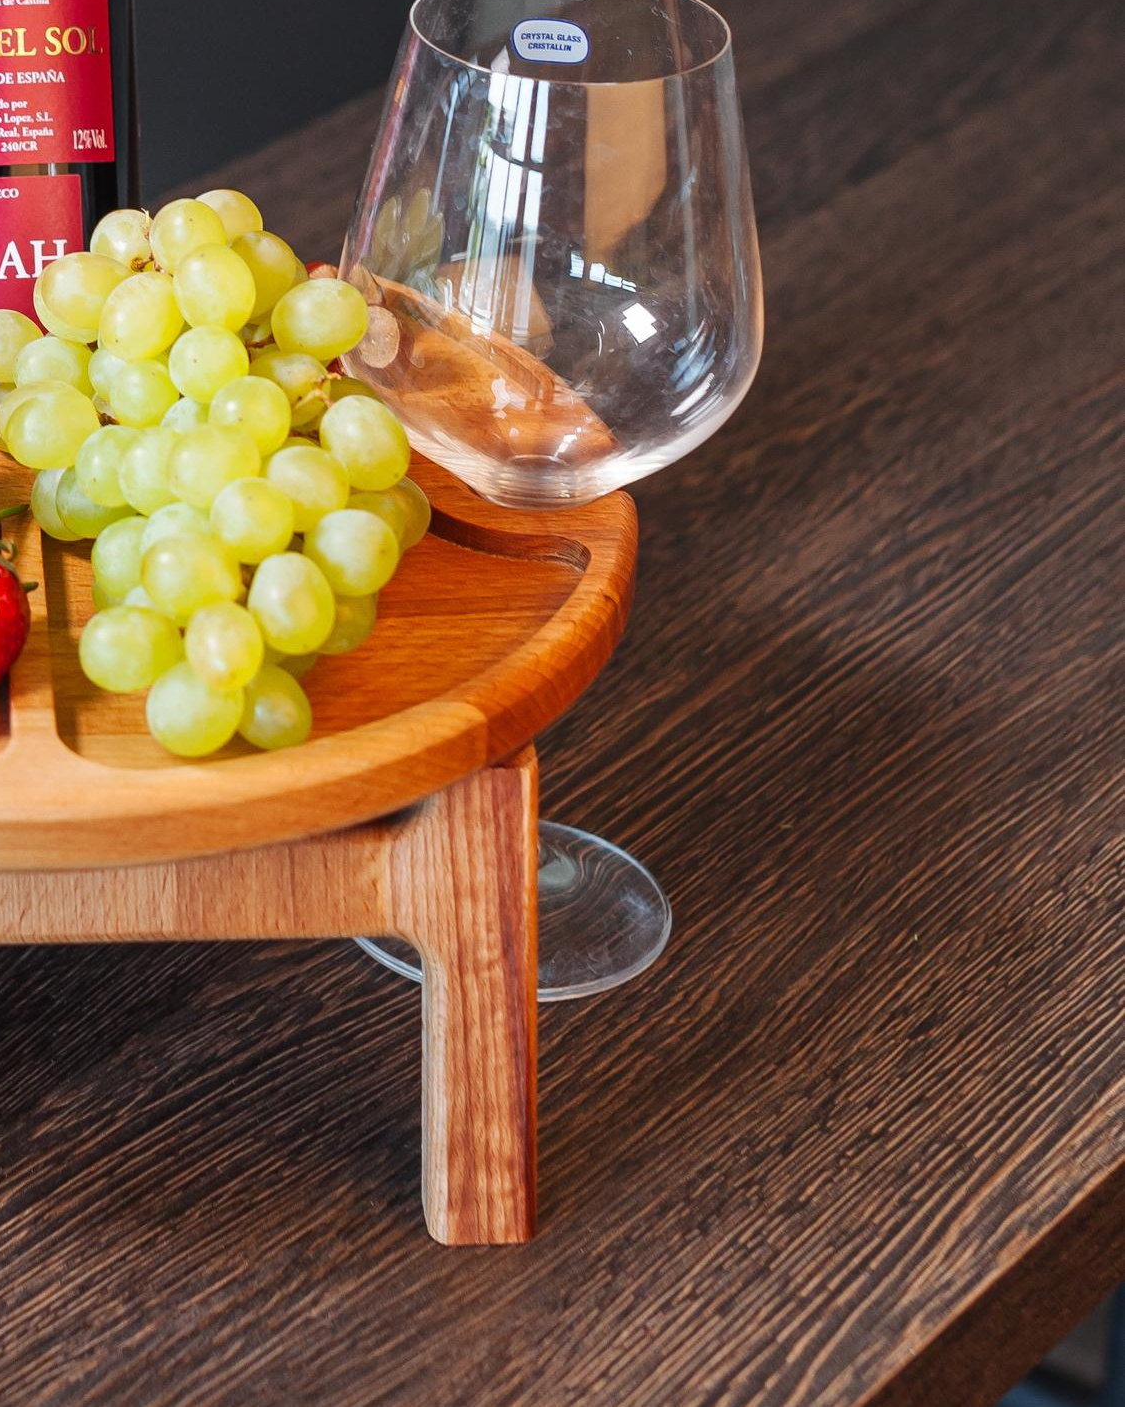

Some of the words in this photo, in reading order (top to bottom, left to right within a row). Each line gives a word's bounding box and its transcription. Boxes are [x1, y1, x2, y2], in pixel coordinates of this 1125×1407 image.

[45, 26, 104, 55] SOL
[521, 32, 554, 40] CRYSTAL
[557, 34, 581, 43] GLASS
[528, 42, 571, 51] CRISTALLIN
[17, 69, 65, 84] ESPAÑA
[11, 100, 27, 110] por
[36, 113, 53, 122] S.L.
[22, 127, 53, 138] España
[1, 141, 38, 152] 240/CR
